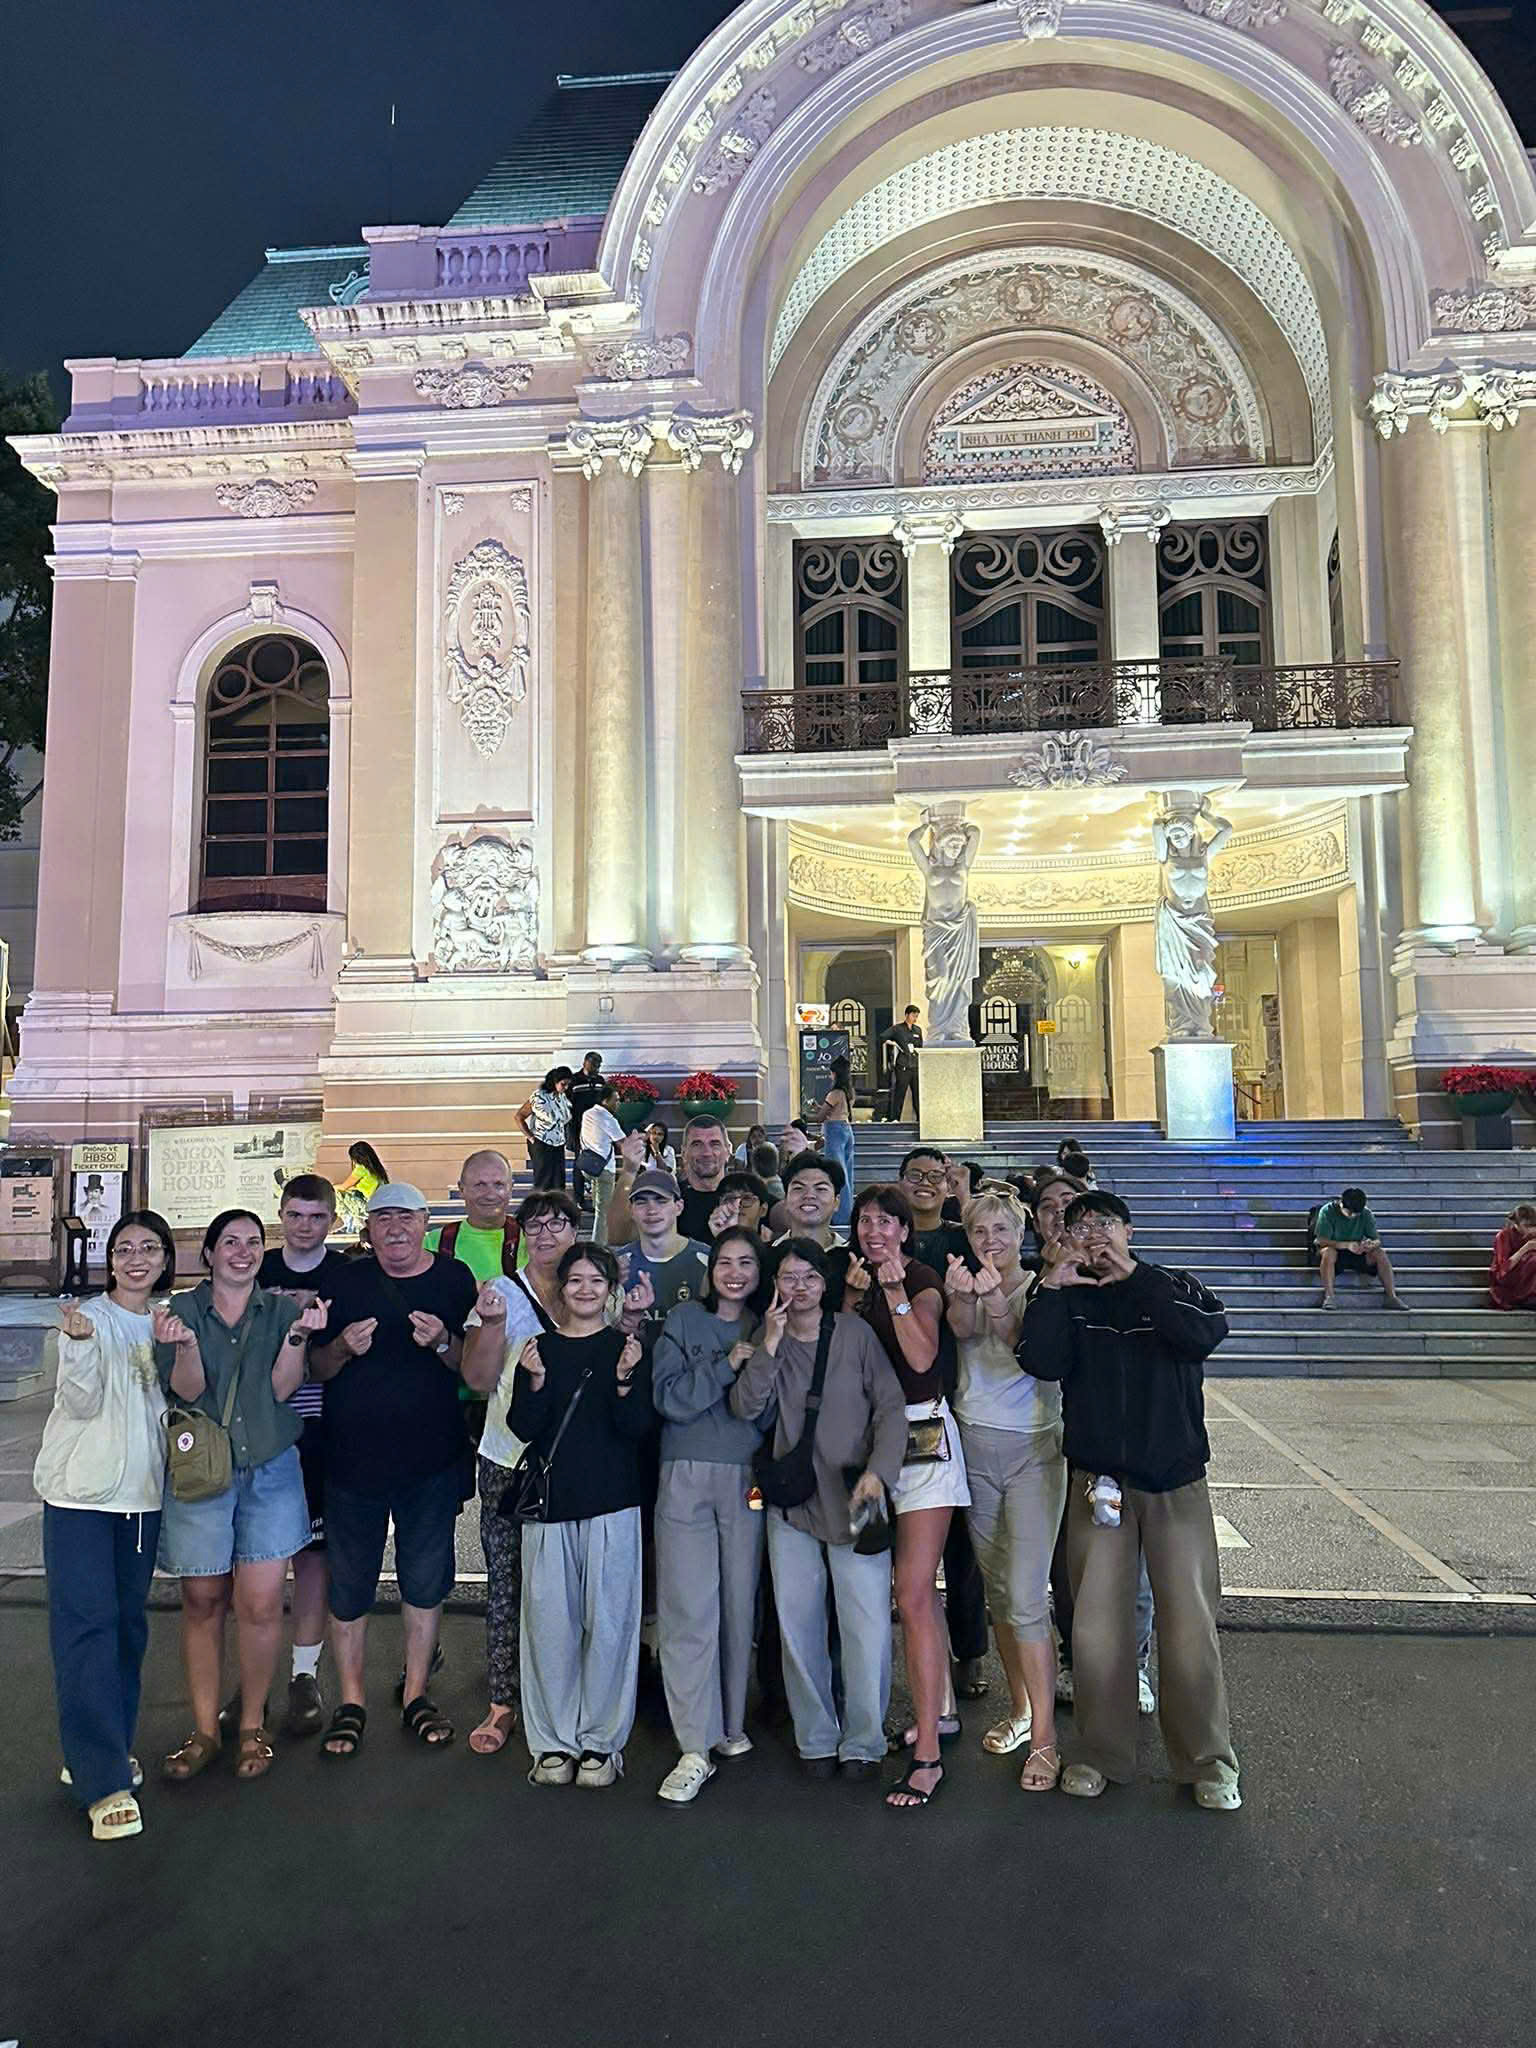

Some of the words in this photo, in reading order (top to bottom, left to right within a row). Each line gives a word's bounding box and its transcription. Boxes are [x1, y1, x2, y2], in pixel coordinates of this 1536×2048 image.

[982, 1053, 1018, 1062] OPERA
[982, 1061, 1018, 1070] HOUSE
[86, 1153, 114, 1161] HBSO
[162, 1145, 225, 1160] SAIGON
[162, 1160, 226, 1176] OPERA
[162, 1174, 226, 1192] HOUSE
